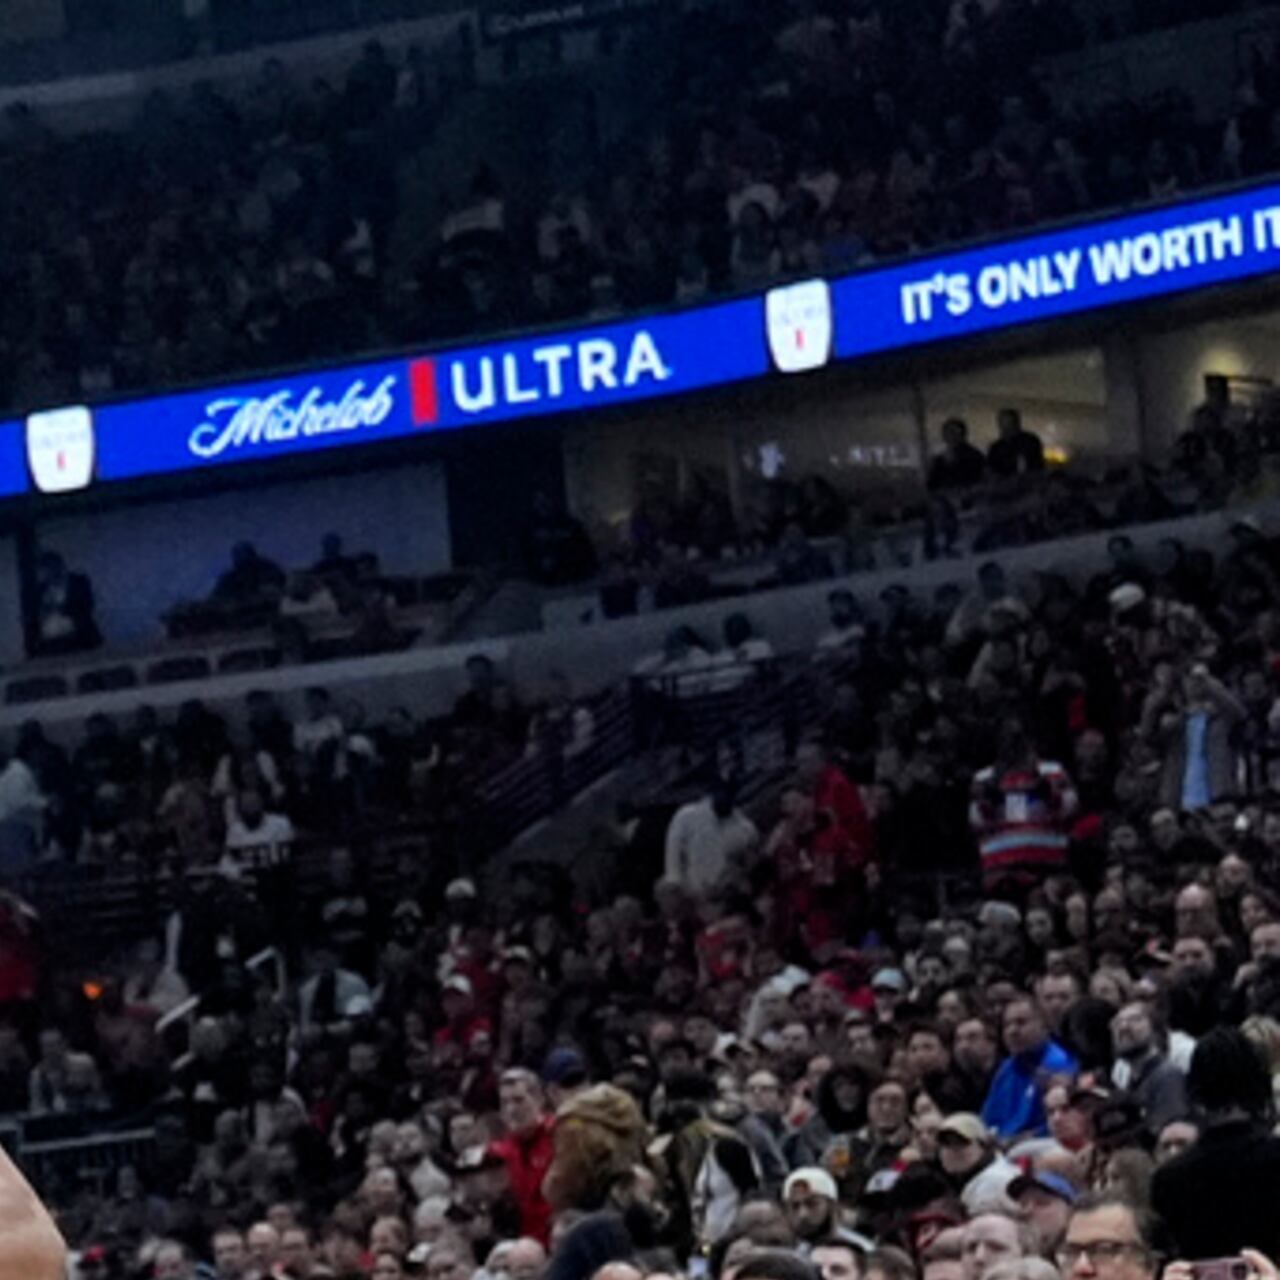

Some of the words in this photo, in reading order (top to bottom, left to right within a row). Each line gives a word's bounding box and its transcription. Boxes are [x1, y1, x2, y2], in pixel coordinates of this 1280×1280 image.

[901, 274, 971, 324] IT'S
[977, 250, 1081, 308] ONLY
[1089, 216, 1244, 285] WORTH
[188, 374, 396, 458] Michelob
[451, 331, 670, 412] ULTRA
